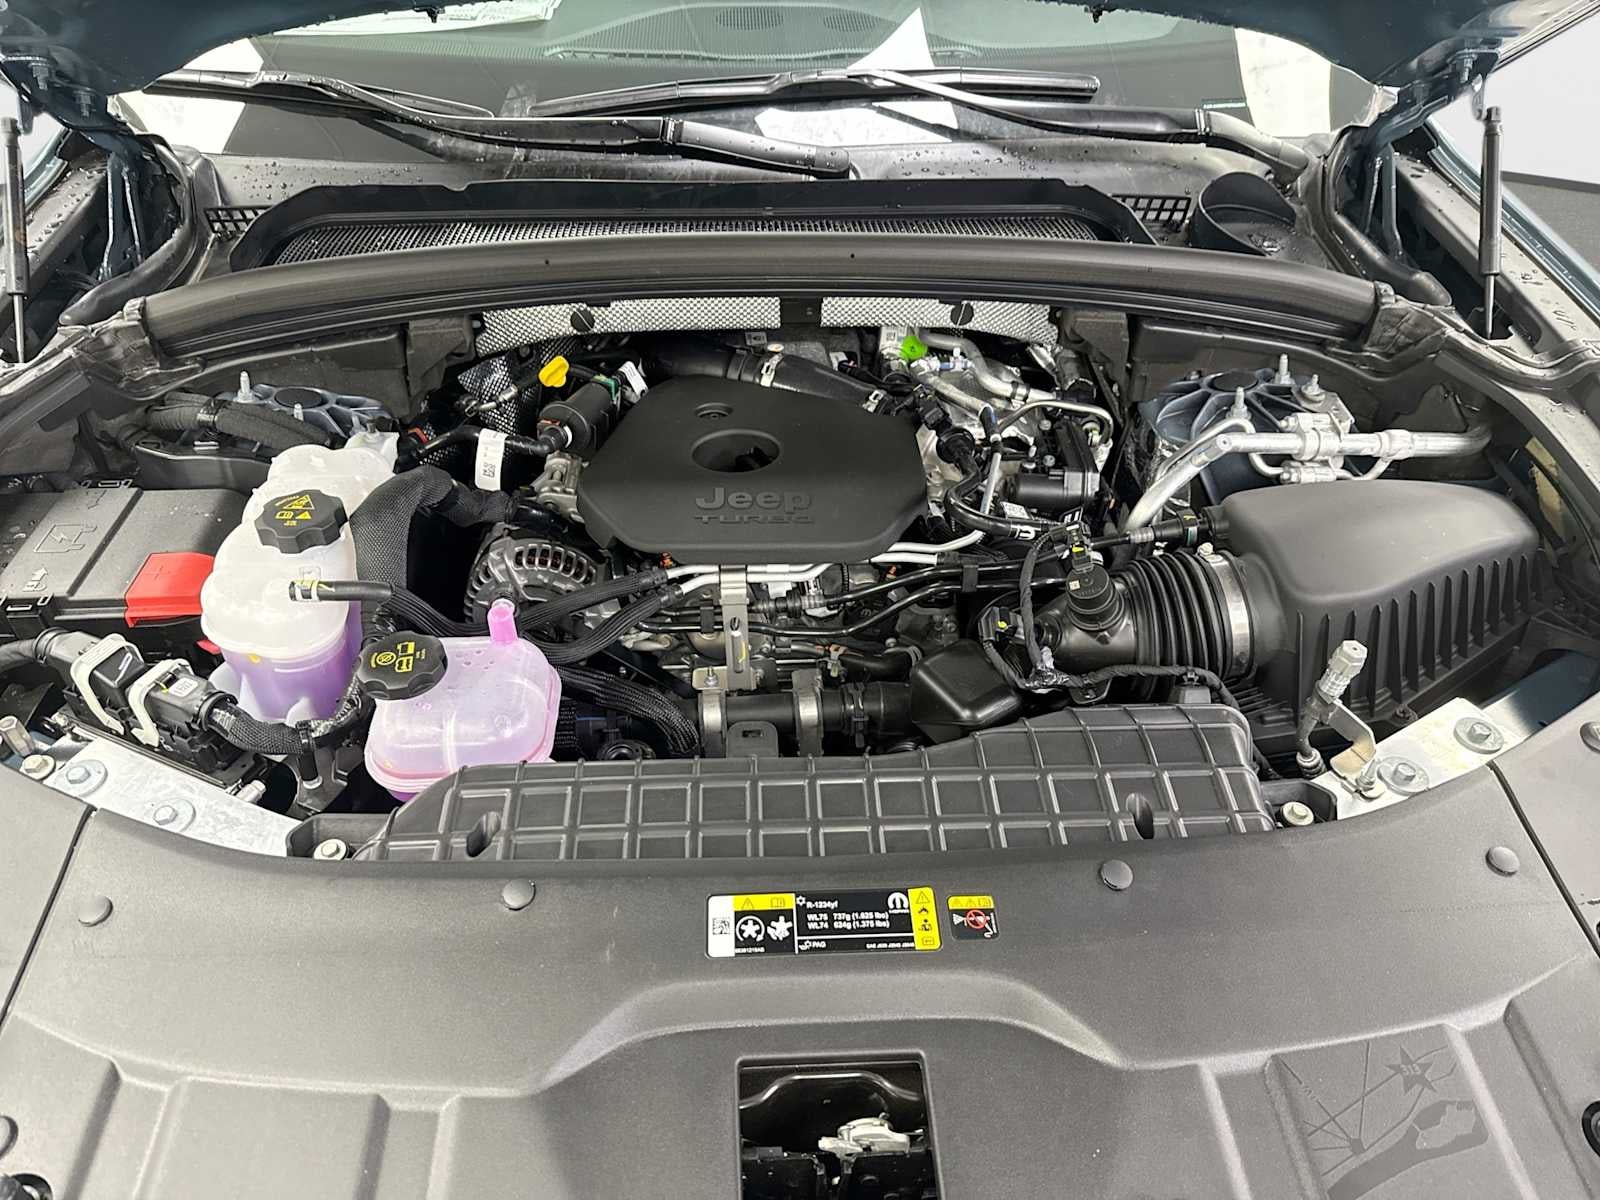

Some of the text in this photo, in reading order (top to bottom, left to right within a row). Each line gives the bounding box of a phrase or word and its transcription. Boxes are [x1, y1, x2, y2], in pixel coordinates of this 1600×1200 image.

[695, 487, 812, 514] Jeep
[694, 514, 814, 525] TURBO
[806, 900, 838, 910] R-1234yf
